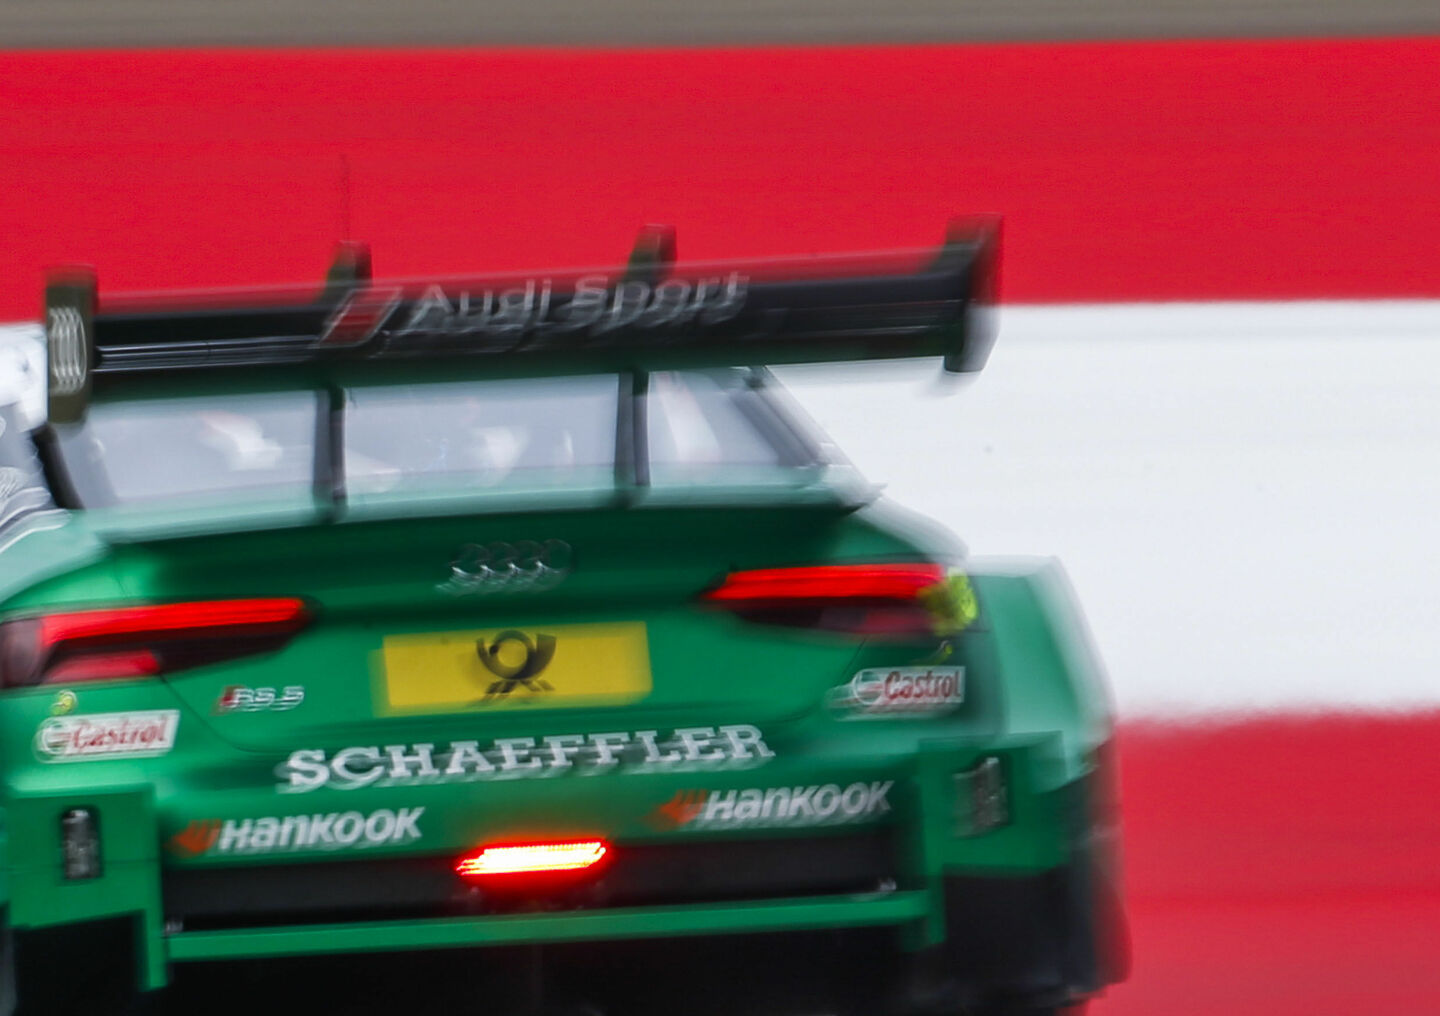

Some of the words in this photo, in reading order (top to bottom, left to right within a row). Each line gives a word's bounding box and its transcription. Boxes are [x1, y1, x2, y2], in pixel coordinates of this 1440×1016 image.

[400, 279, 553, 333] Audi
[564, 272, 750, 335] Sport
[882, 669, 962, 701] Castrol
[71, 715, 169, 752] Castrol
[282, 725, 776, 791] SCHAEFFLER
